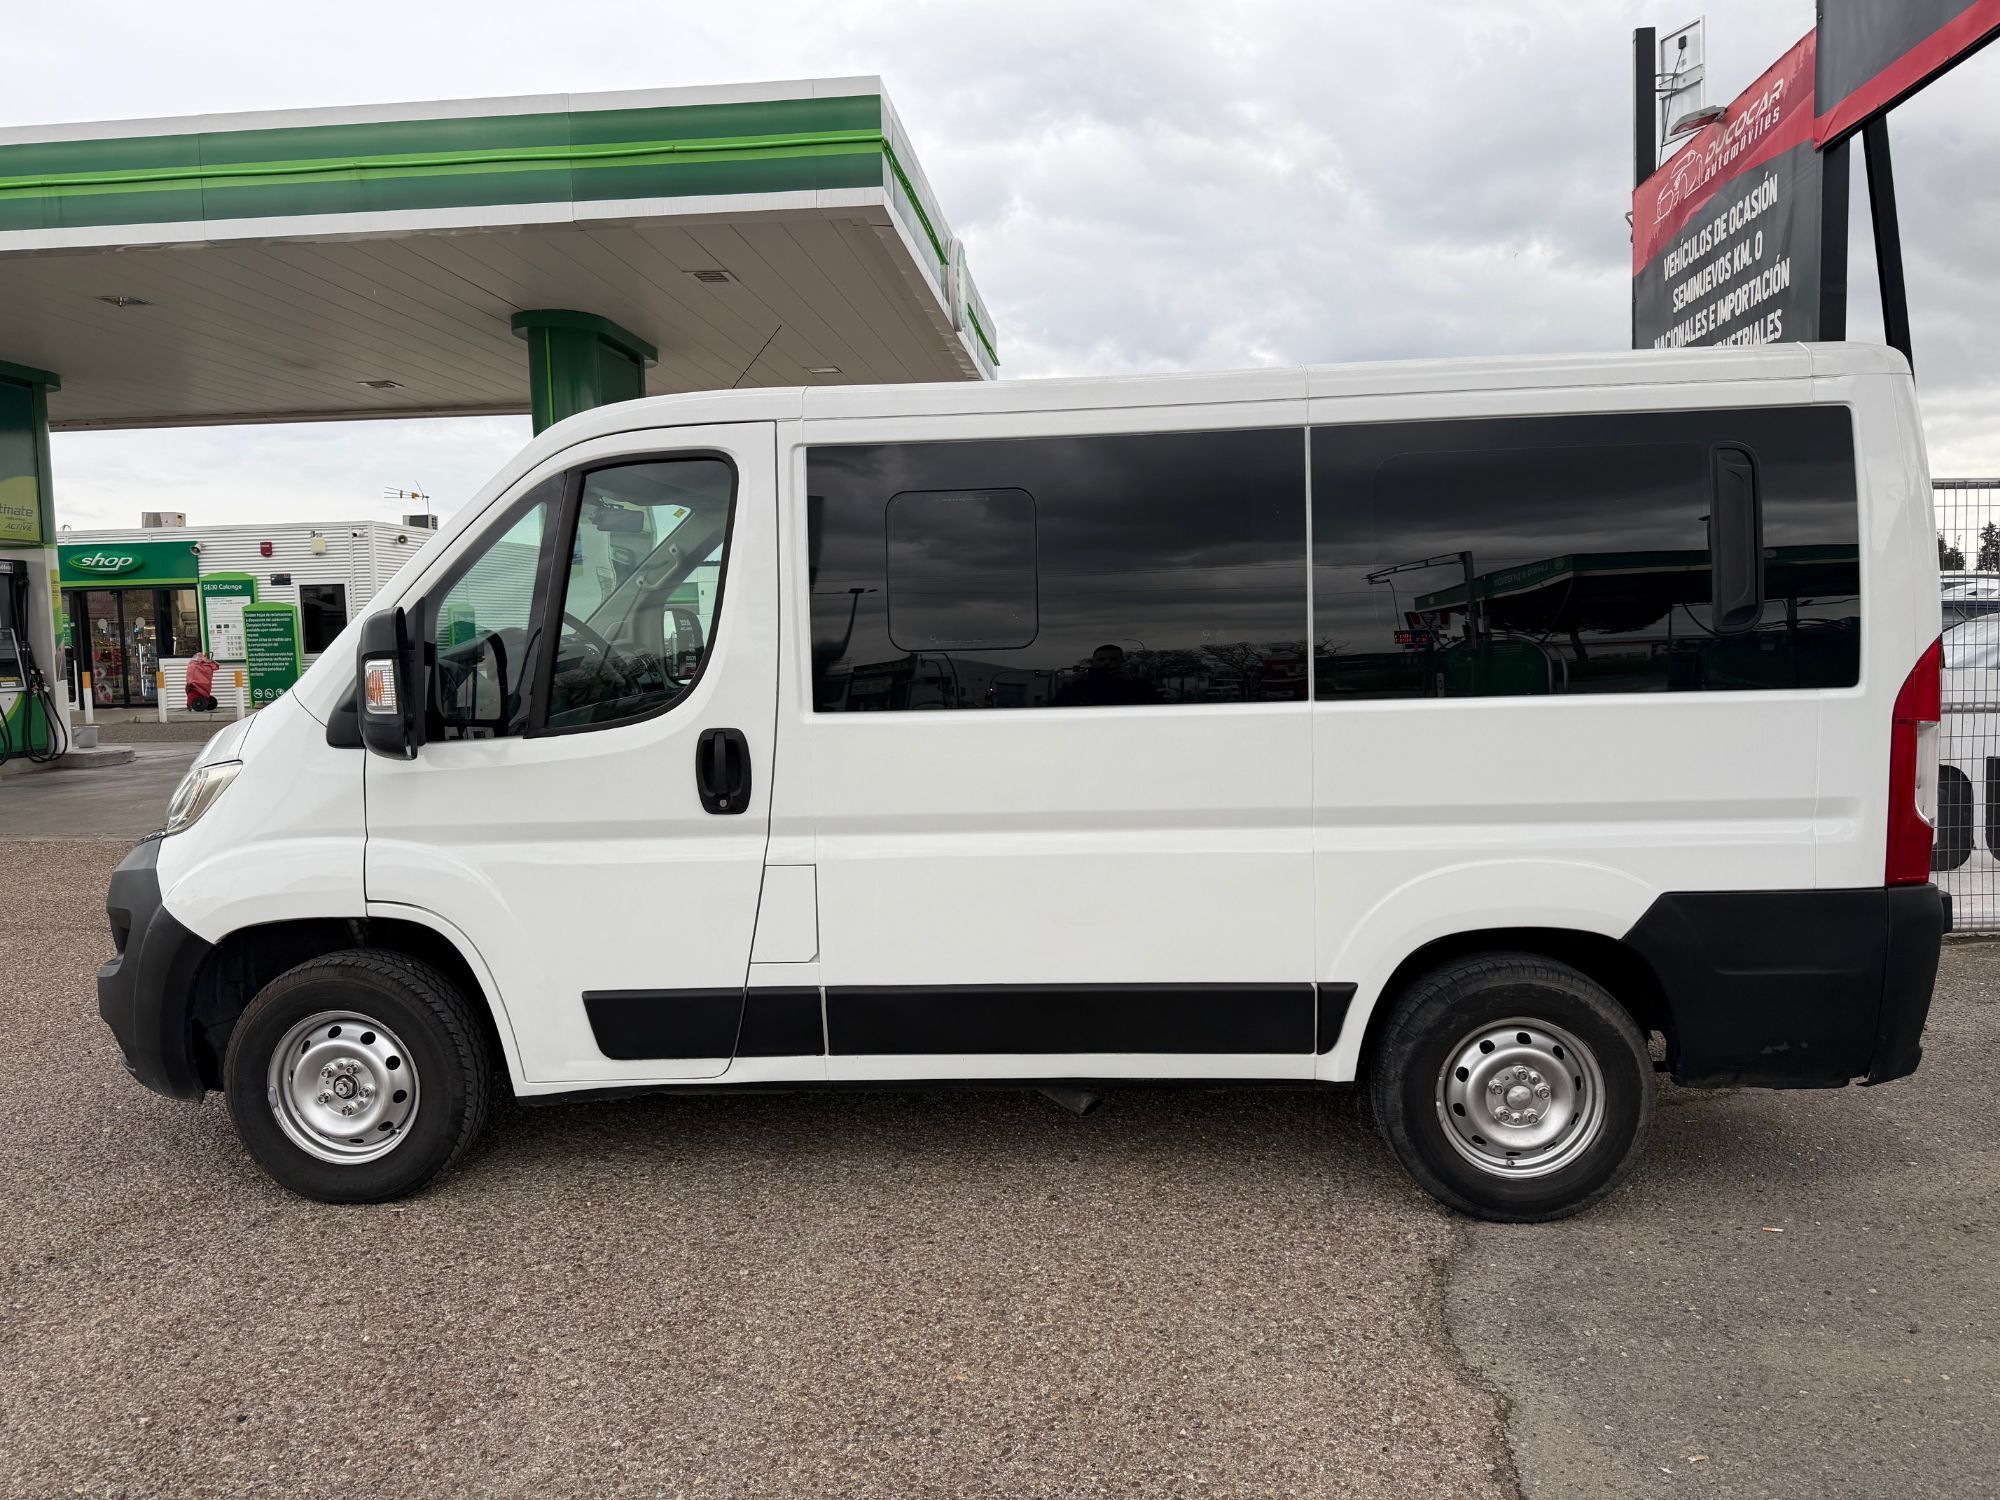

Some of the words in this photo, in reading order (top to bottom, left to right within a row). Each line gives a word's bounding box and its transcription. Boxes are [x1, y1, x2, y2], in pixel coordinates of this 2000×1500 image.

[1704, 78, 1784, 165] DUCOCAR
[1663, 238, 1712, 281] VEHÍCULOS
[1713, 212, 1728, 246] DE
[1728, 171, 1778, 235] OCASIÓN
[1672, 251, 1731, 313] SEMINUEVOS
[1733, 239, 1752, 275] KM.
[1708, 304, 1716, 331] E
[1716, 253, 1790, 327] IMPORTACIÓN
[81, 552, 133, 571] shop
